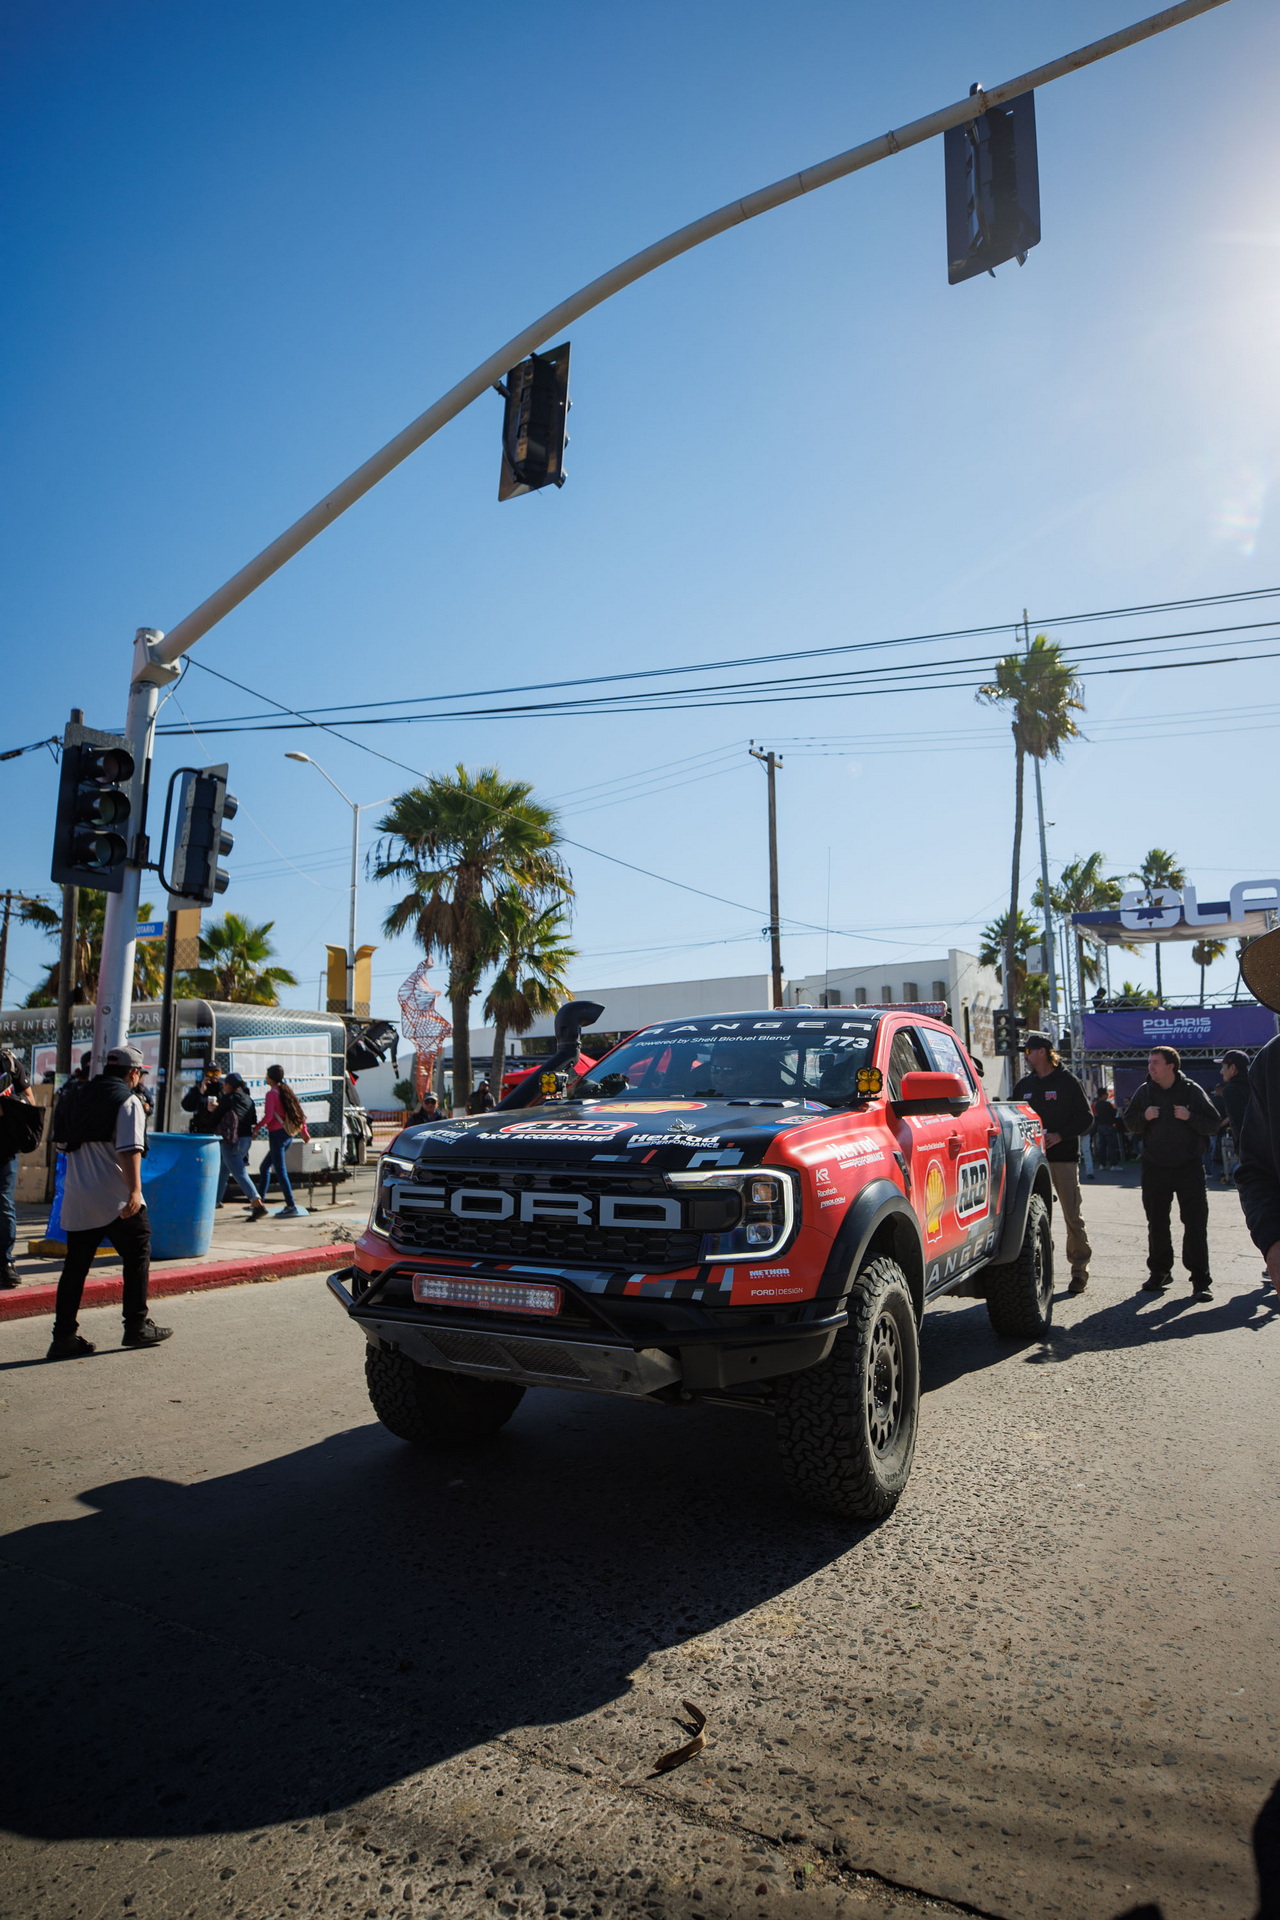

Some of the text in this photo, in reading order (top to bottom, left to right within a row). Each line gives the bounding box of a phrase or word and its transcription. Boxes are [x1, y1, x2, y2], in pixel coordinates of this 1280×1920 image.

[1142, 1016, 1212, 1028] POLARIS
[637, 1021, 873, 1037] RANGER
[1172, 1025, 1212, 1034] RACING
[634, 1038, 677, 1048] Powered
[823, 1035, 870, 1050] 773
[510, 1133, 617, 1142] ACCESSORIES
[627, 1133, 721, 1144] Herrod
[648, 1139, 720, 1149] PERFORMANCE
[825, 1135, 880, 1161] Herrod
[815, 1167, 831, 1183] KR
[390, 1183, 682, 1230] FORD
[925, 1231, 995, 1289] ANGER
[749, 1268, 790, 1277] METHOD
[751, 1287, 804, 1297] FORD DESIGN
